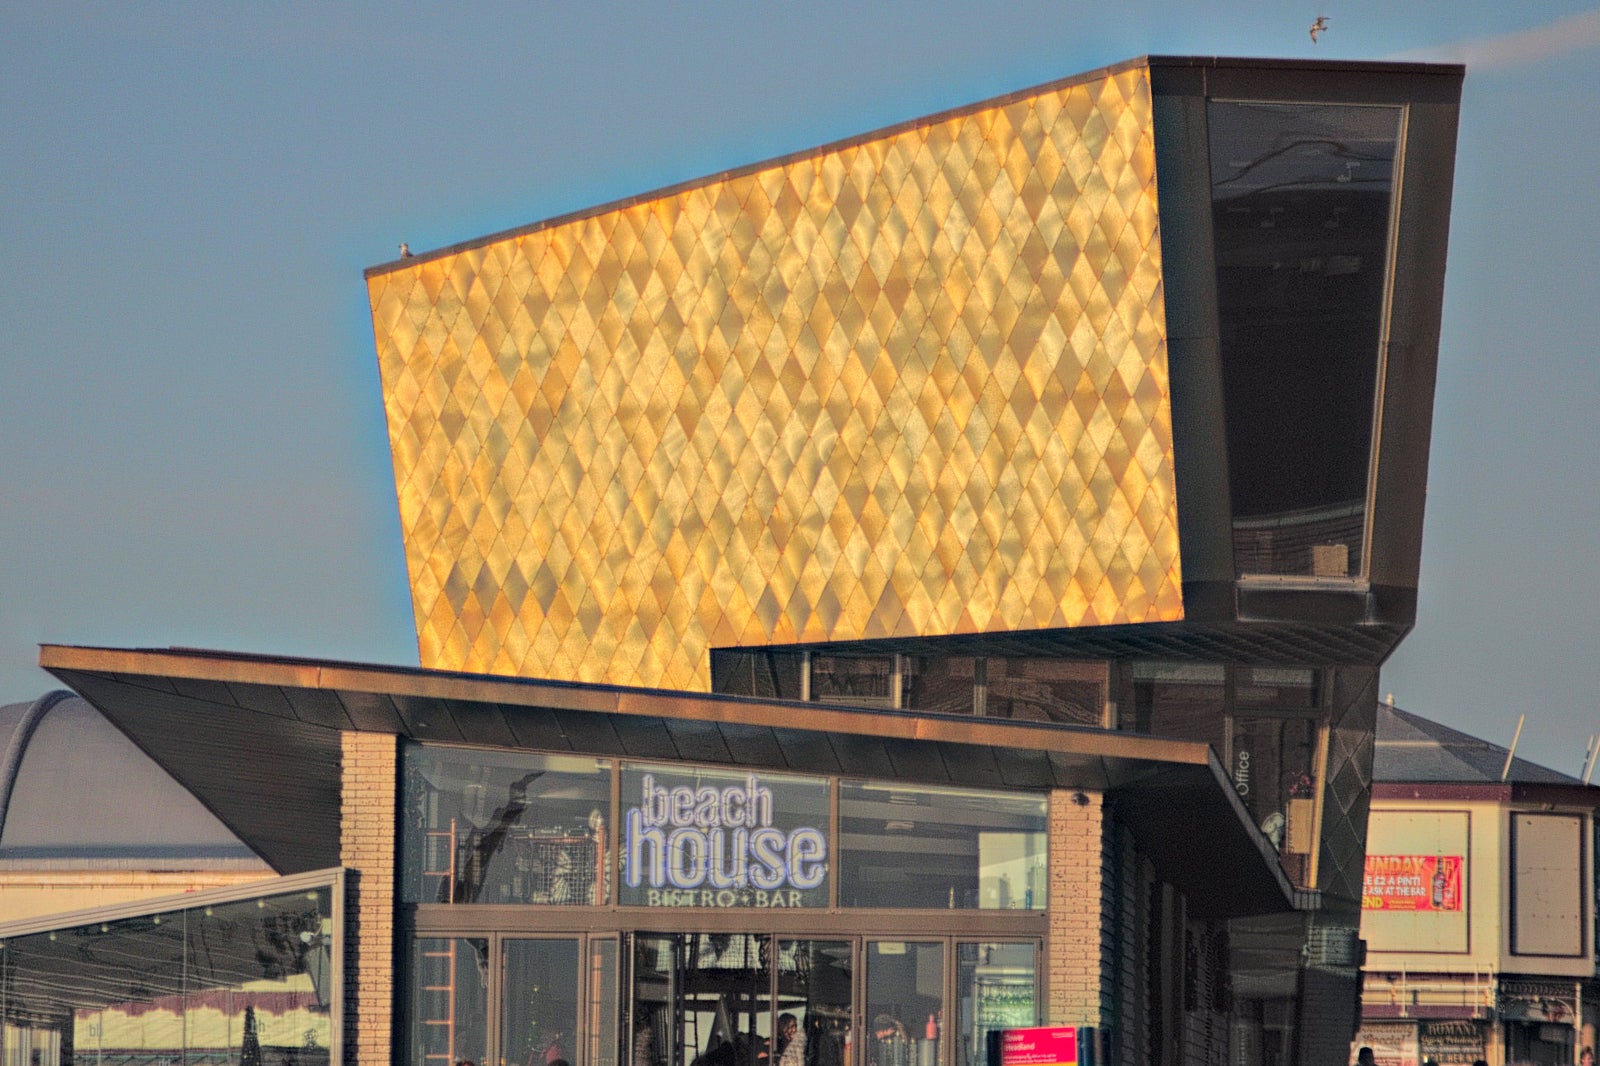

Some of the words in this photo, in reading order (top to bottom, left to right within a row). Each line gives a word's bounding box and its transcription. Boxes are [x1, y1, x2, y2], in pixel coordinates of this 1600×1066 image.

[1233, 752, 1249, 795] Office
[641, 773, 774, 827] beach
[626, 808, 827, 890] house
[647, 890, 735, 908] BISTRO
[754, 890, 802, 908] BAR
[1370, 887, 1383, 897] ASK
[1385, 887, 1395, 897] AT
[1397, 887, 1410, 897] THE
[1411, 887, 1426, 898] BAR
